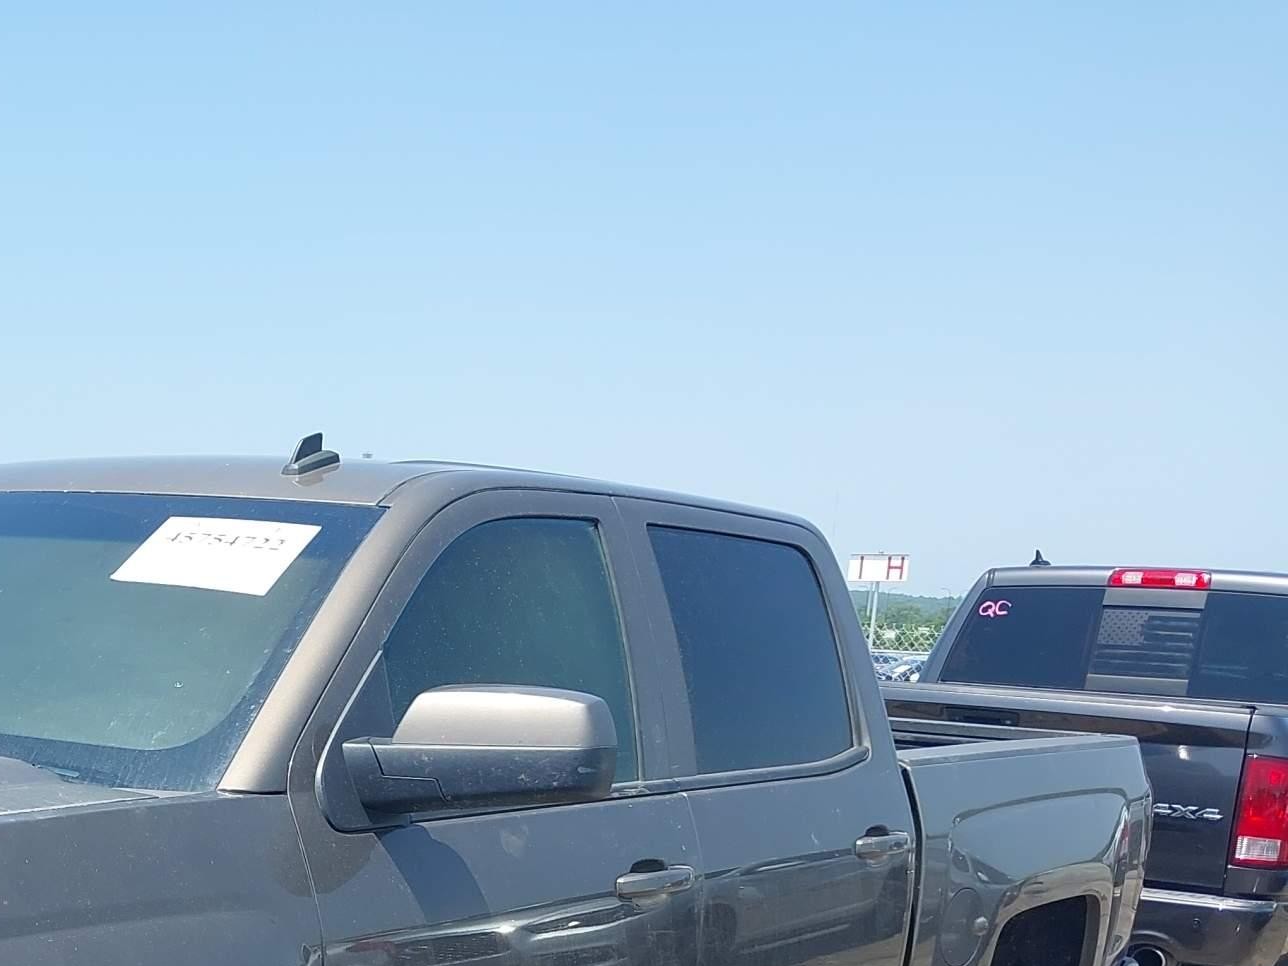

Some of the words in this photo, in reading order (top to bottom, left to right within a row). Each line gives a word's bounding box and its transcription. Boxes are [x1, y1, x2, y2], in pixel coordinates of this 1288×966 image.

[886, 555, 905, 580] H
[978, 600, 1012, 617] QC
[1152, 803, 1224, 821] 4X4
